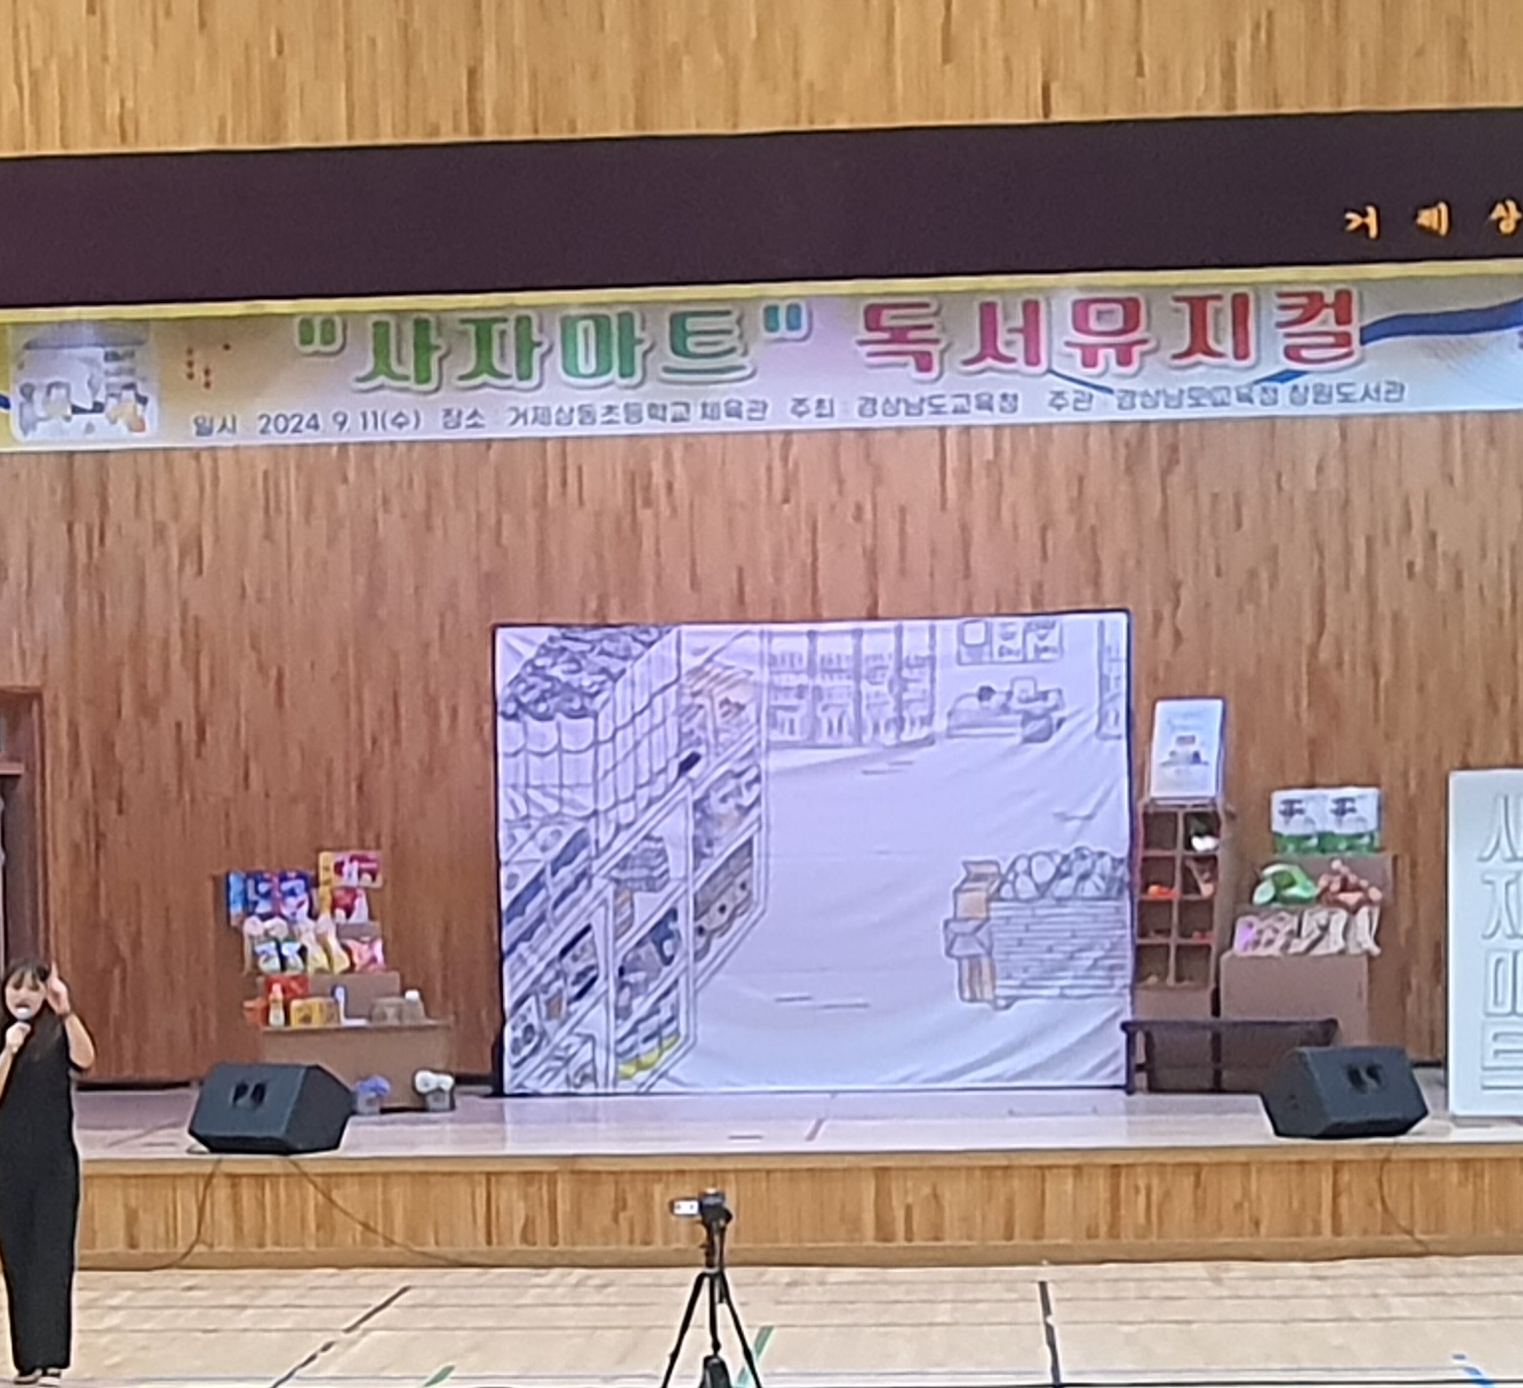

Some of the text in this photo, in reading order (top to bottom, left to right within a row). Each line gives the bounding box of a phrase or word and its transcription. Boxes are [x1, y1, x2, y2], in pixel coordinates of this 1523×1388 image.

[297, 288, 1356, 387] "사자마트" 독서뮤지컬
[193, 414, 238, 437] 일시
[360, 408, 422, 432] 11(수)
[441, 407, 487, 430] 장소
[507, 401, 691, 427] 거제상동초등학교
[700, 398, 769, 422] 체육관
[790, 396, 835, 419] 주최
[857, 391, 1019, 418] 경상남도교육청
[1047, 389, 1095, 413] 주관
